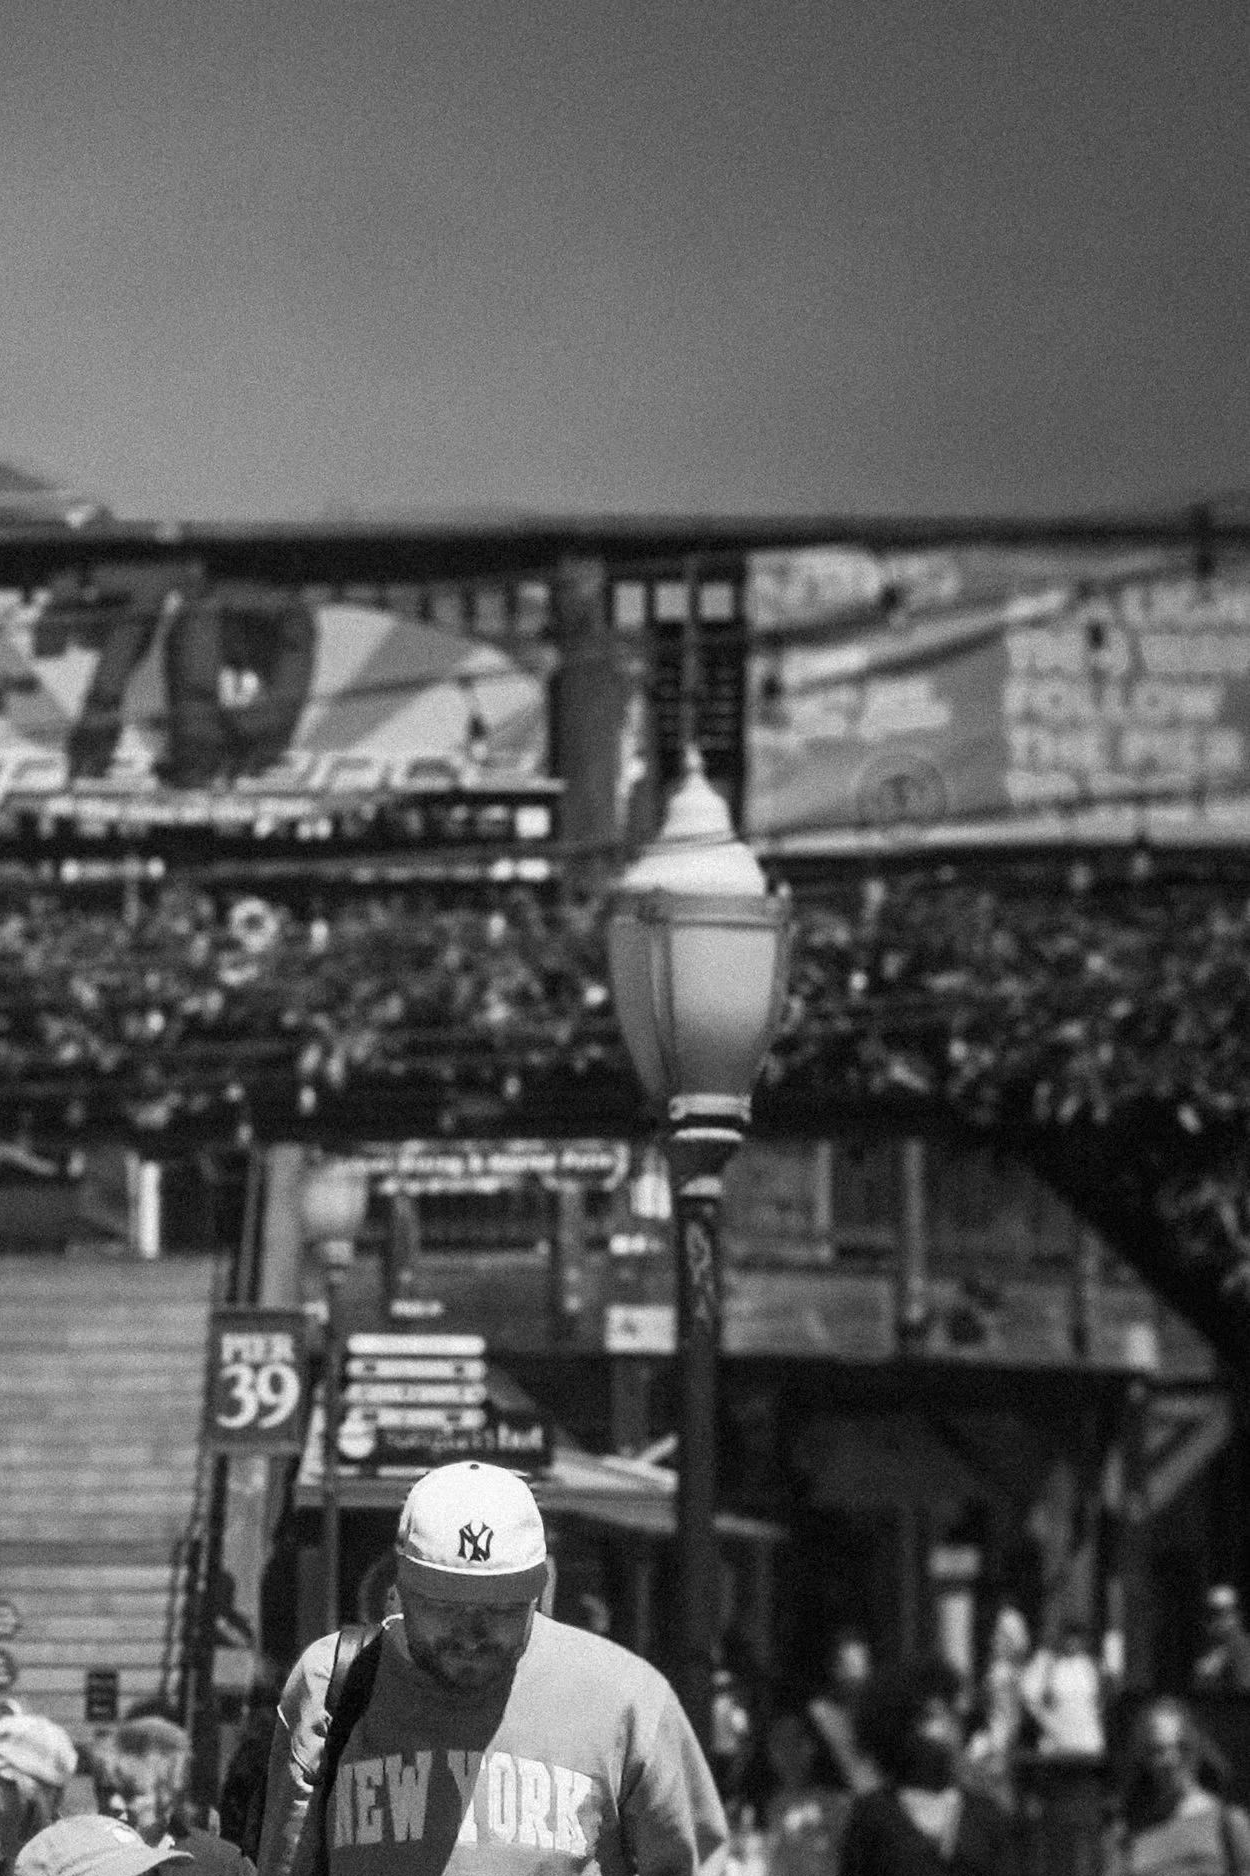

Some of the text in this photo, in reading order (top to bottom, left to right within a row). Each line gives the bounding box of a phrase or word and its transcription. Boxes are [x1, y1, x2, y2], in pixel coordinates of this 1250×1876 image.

[216, 1362, 300, 1429] 39
[457, 1520, 494, 1563] NY
[447, 1749, 593, 1858] YORK
